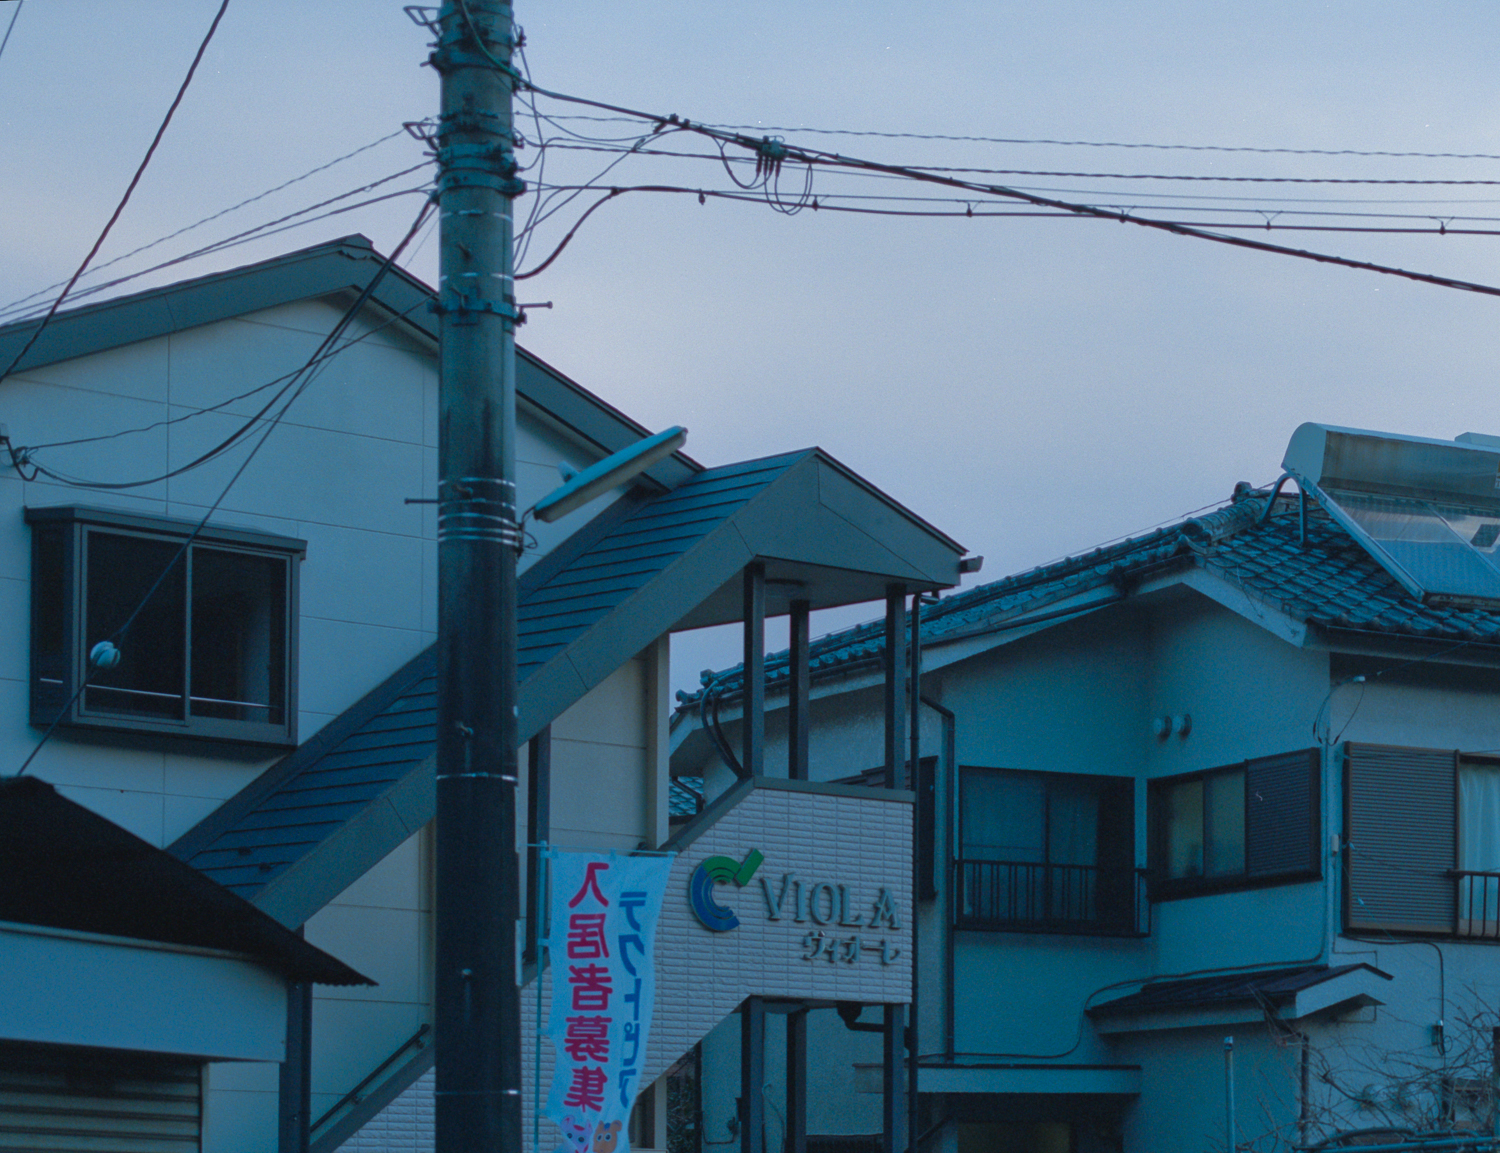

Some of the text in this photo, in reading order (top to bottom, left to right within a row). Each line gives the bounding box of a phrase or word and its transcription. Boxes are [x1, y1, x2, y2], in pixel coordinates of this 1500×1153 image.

[759, 871, 902, 930] VIOLA
[801, 930, 901, 965] ヴィオーレ
